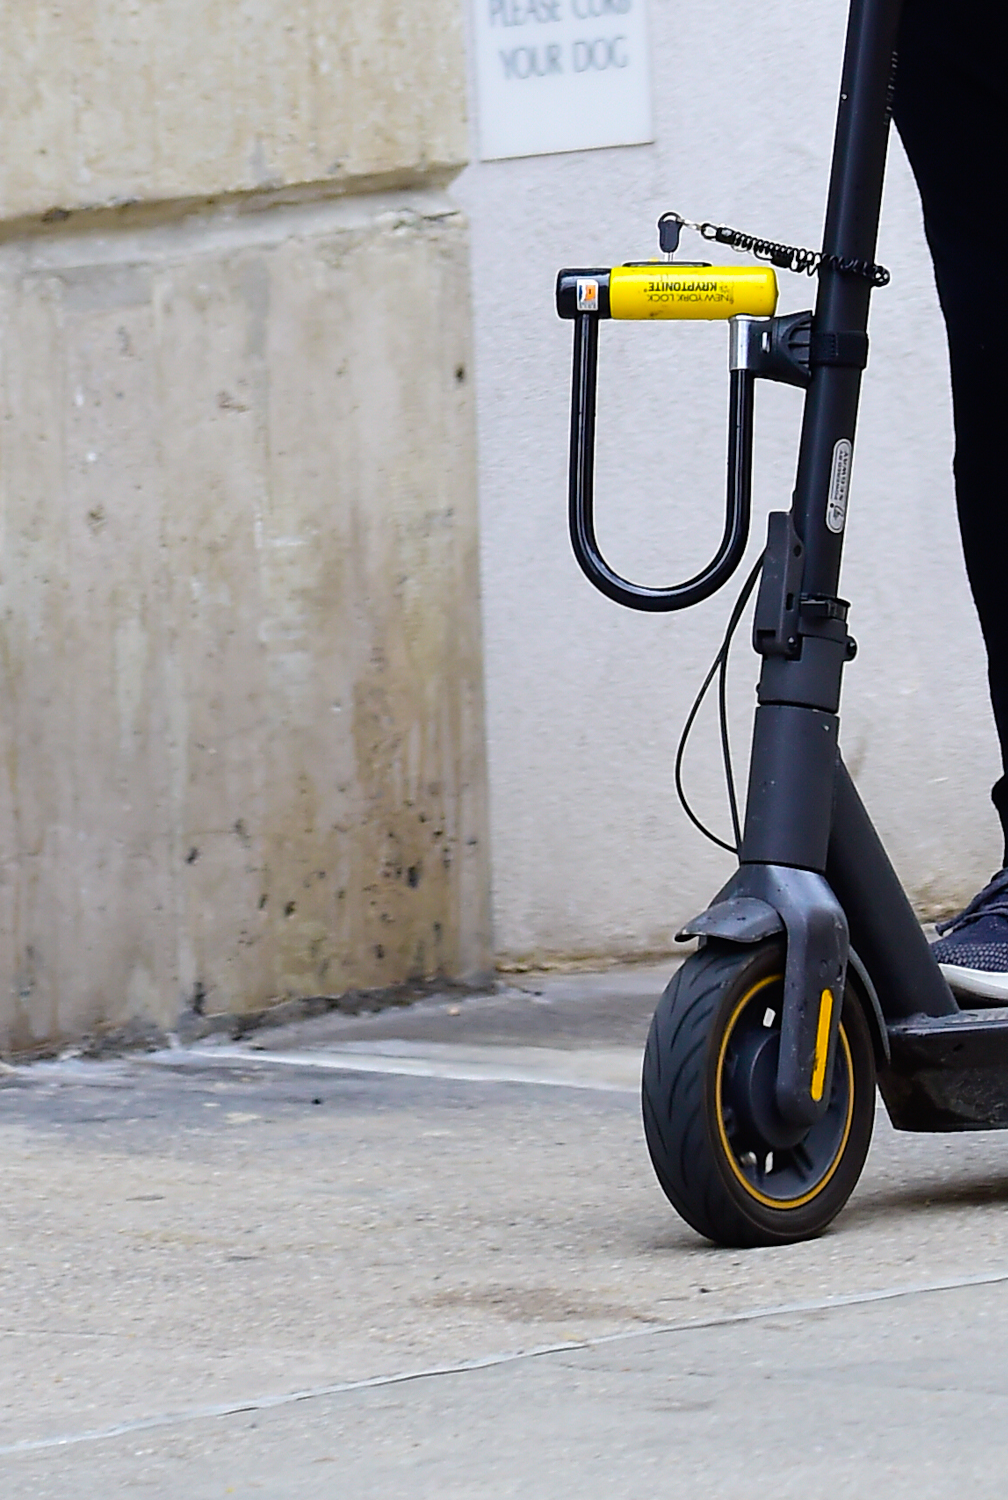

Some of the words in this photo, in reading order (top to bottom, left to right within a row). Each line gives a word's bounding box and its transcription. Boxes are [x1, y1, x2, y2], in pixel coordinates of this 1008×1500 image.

[498, 43, 563, 80] YOUR
[572, 35, 629, 73] DOG
[647, 293, 674, 302] LOCK
[676, 293, 703, 302] YORK
[704, 293, 729, 302] NEW
